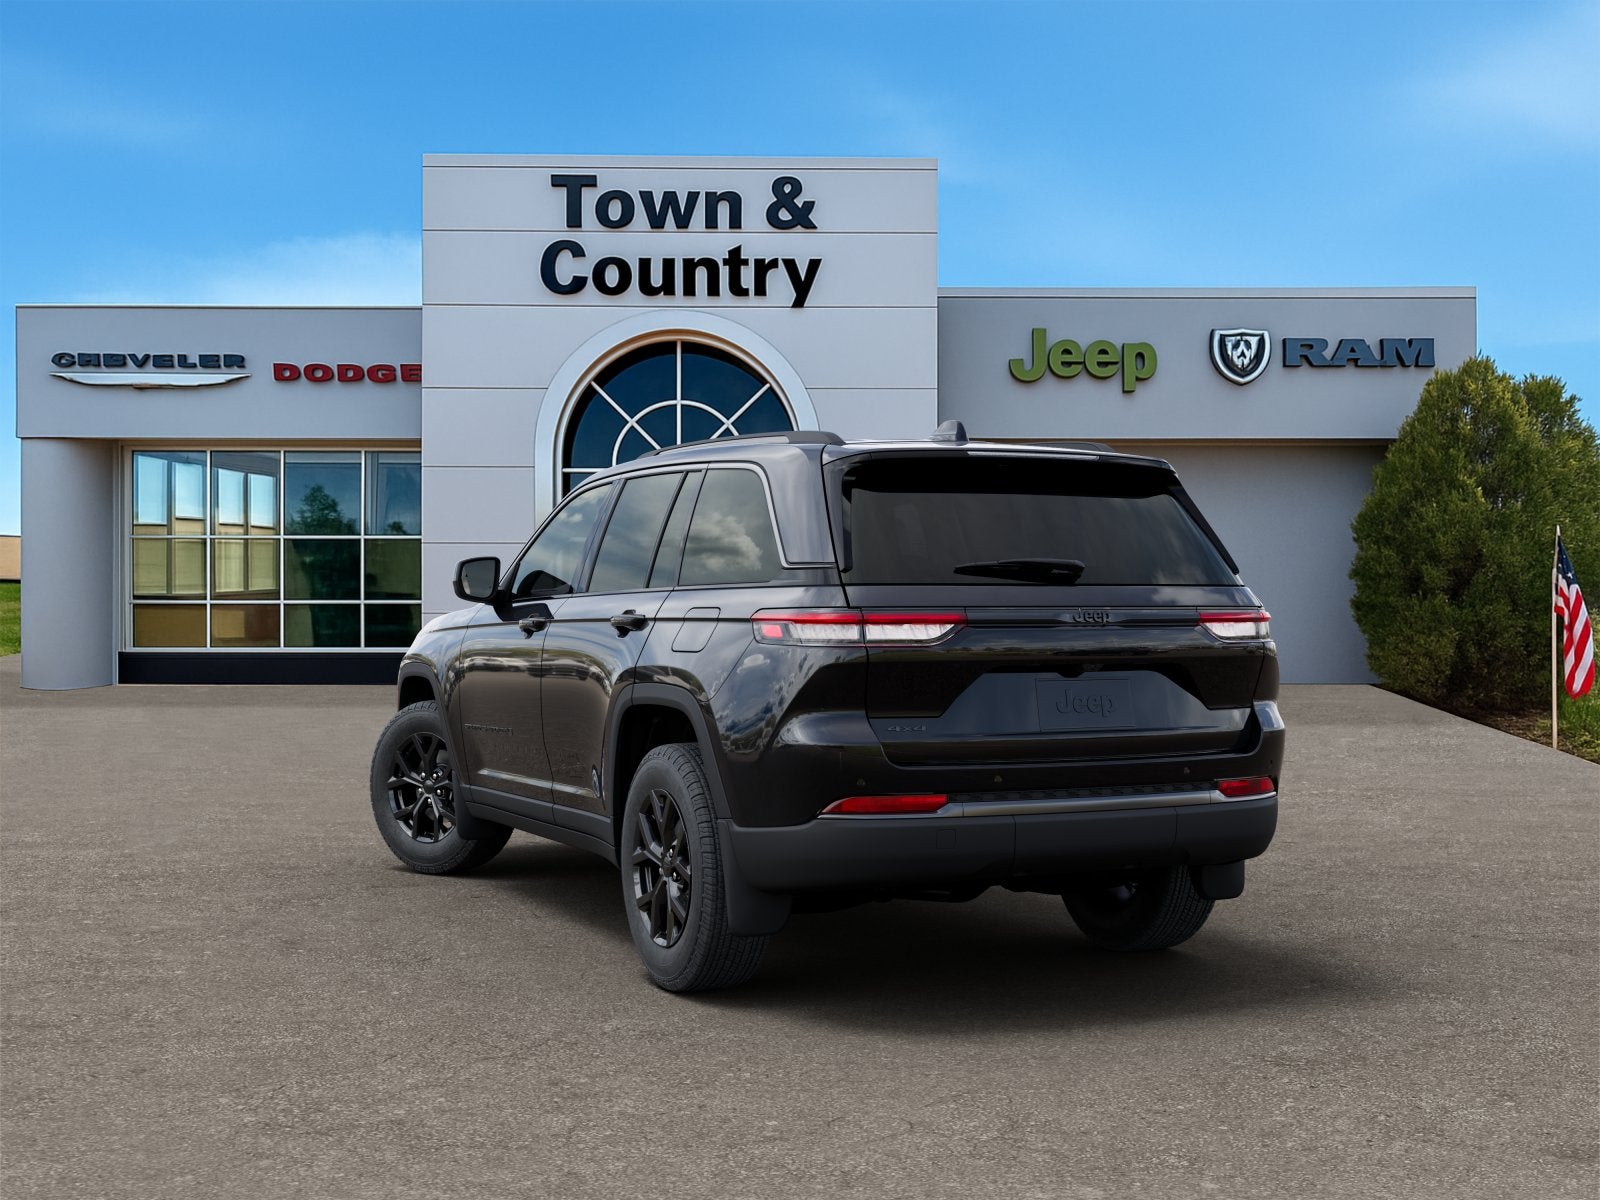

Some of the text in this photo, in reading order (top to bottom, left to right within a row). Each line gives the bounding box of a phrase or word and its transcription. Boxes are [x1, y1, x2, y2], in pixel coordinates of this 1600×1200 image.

[550, 174, 818, 230] Town &
[540, 239, 822, 308] Country
[1008, 327, 1157, 393] Jeep
[1282, 337, 1436, 367] RAM
[273, 362, 422, 383] DODGE
[1072, 607, 1111, 625] Jeep
[1055, 687, 1117, 717] Jeep
